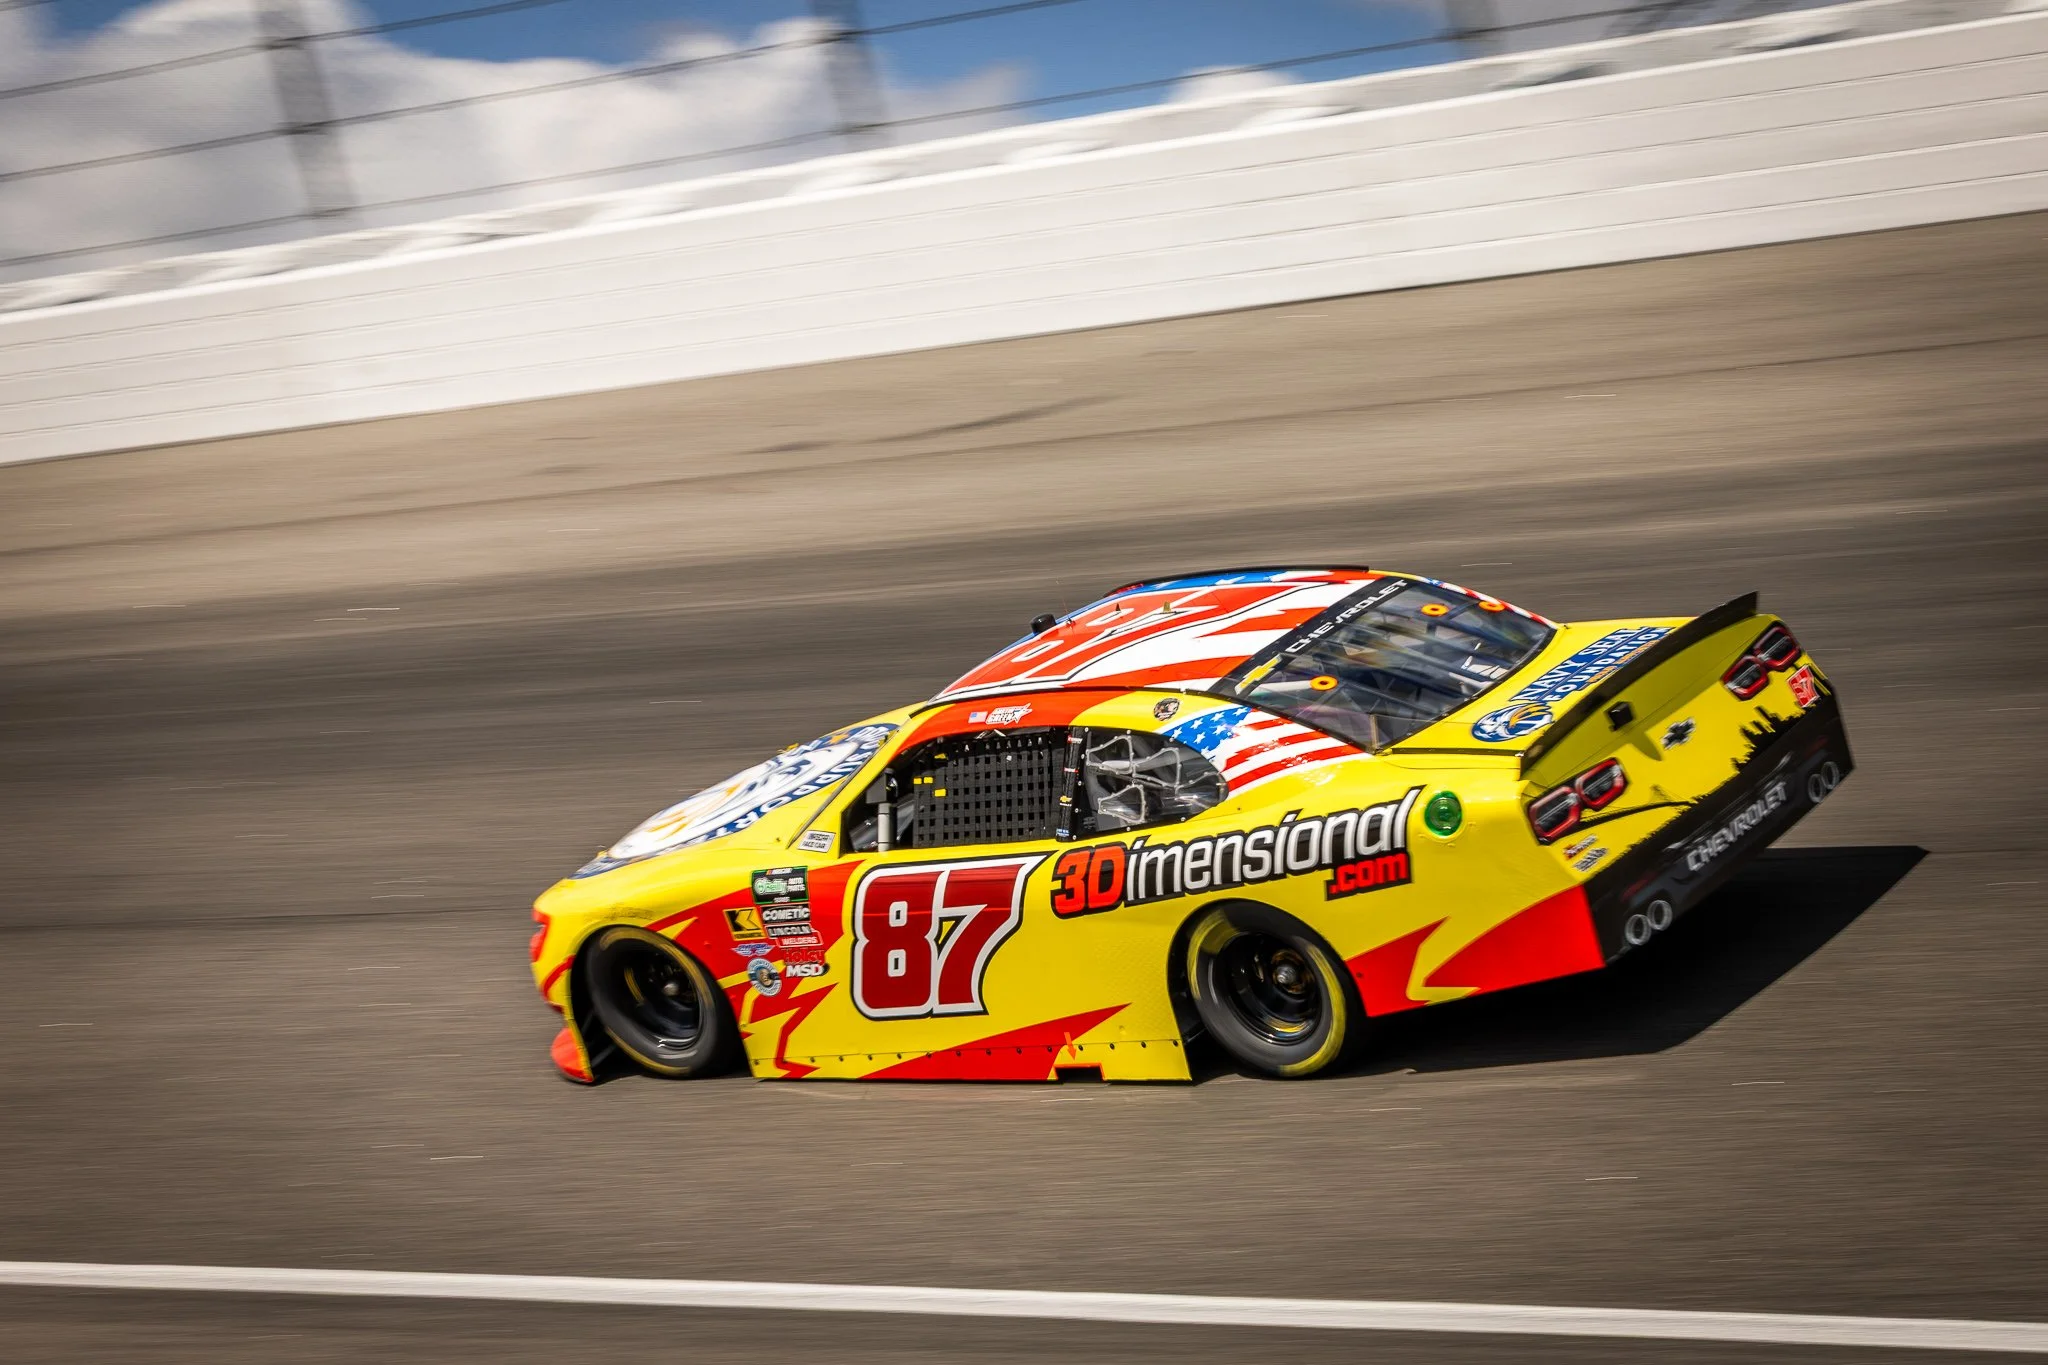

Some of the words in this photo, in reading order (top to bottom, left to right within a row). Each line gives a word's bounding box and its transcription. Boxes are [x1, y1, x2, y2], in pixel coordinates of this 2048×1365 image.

[1285, 579, 1408, 653] CHEVROLET
[1511, 660, 1587, 701] NAVY
[1580, 627, 1649, 656] SEAL
[1547, 628, 1671, 702] FOUNDATION
[1053, 786, 1424, 918] 3Dimensional
[1687, 781, 1789, 872] CHEVROLET
[1328, 853, 1411, 896] .com
[762, 907, 811, 921] COMETIC
[767, 925, 812, 937] LINCOLN
[782, 936, 818, 946] WELDERS
[852, 851, 1057, 1020] 87
[786, 964, 824, 978] MSD
